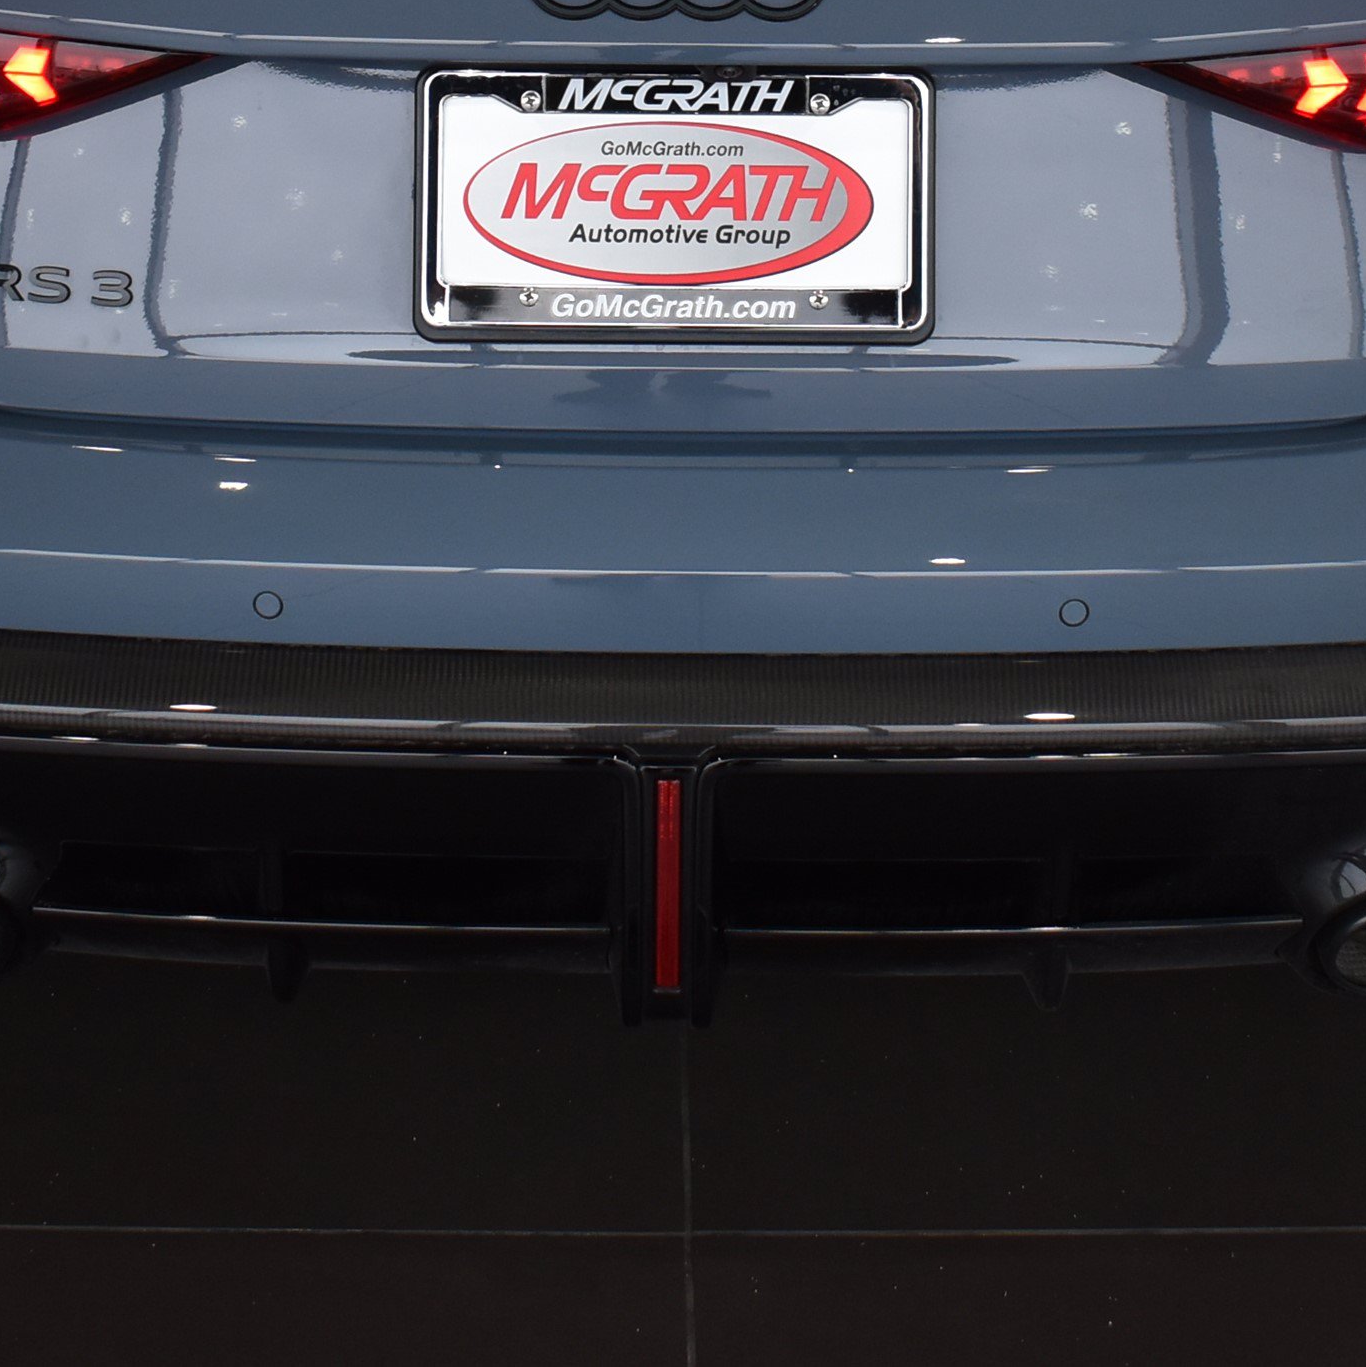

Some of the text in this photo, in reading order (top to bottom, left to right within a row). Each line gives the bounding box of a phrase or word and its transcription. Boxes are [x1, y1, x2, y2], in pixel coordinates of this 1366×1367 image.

[601, 141, 744, 157] GoMcGrath.com
[569, 224, 791, 248] Automotive Group
[91, 270, 133, 307] 3
[552, 293, 795, 320] GoMcGrath.com
